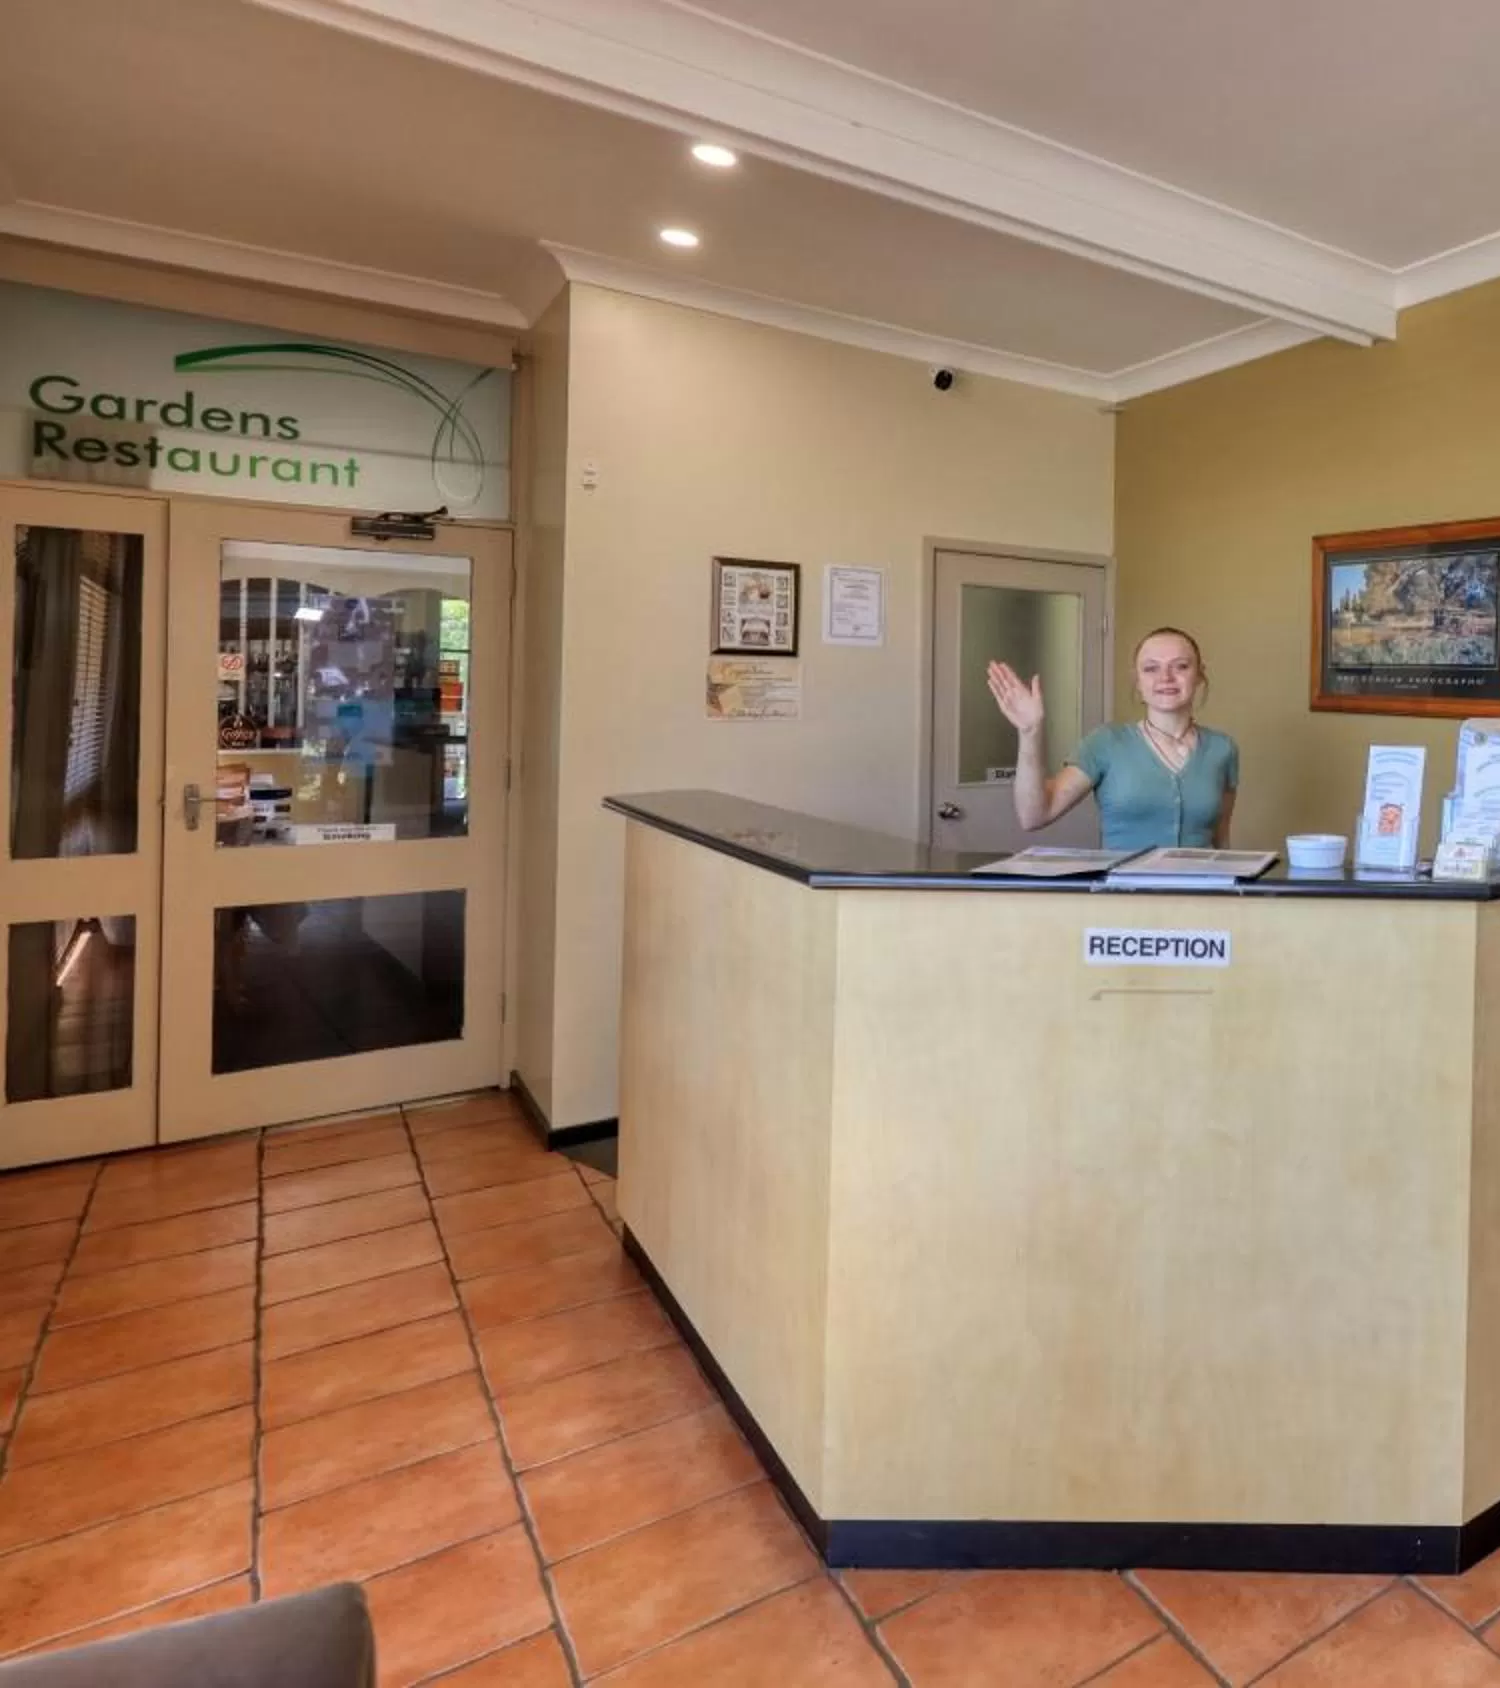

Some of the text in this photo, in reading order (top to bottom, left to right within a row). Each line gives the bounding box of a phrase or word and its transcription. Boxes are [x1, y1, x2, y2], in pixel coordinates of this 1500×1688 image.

[29, 375, 300, 440] Gardens
[33, 420, 361, 488] Restaurant
[1089, 935, 1225, 958] RECEPTION
